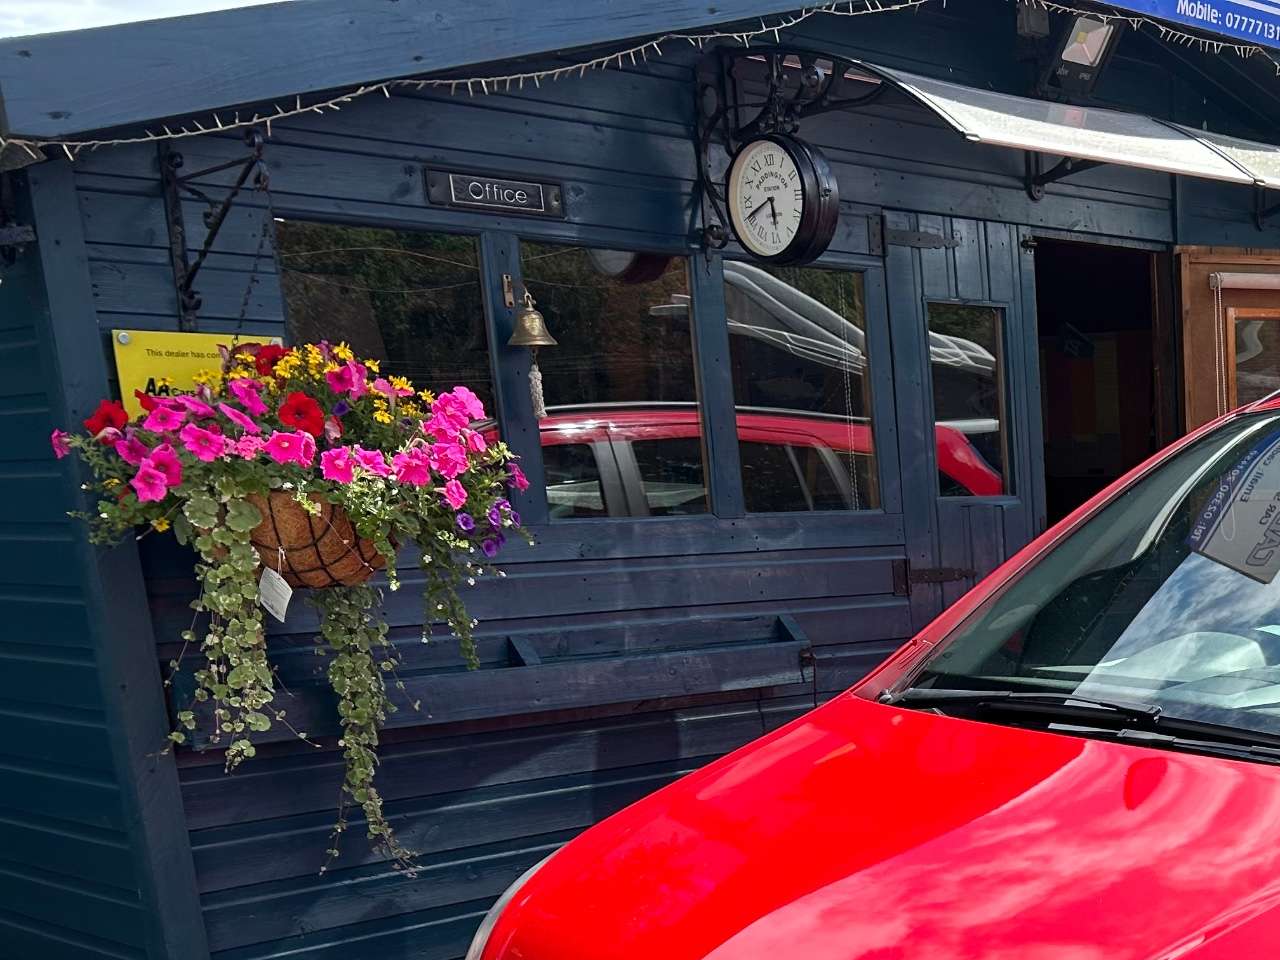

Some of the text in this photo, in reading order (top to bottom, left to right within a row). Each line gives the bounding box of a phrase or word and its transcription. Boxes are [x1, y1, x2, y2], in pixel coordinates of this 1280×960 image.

[1177, 0, 1222, 25] Mobile:
[468, 181, 527, 204] Office
[145, 348, 163, 357] This
[164, 350, 189, 358] dealer
